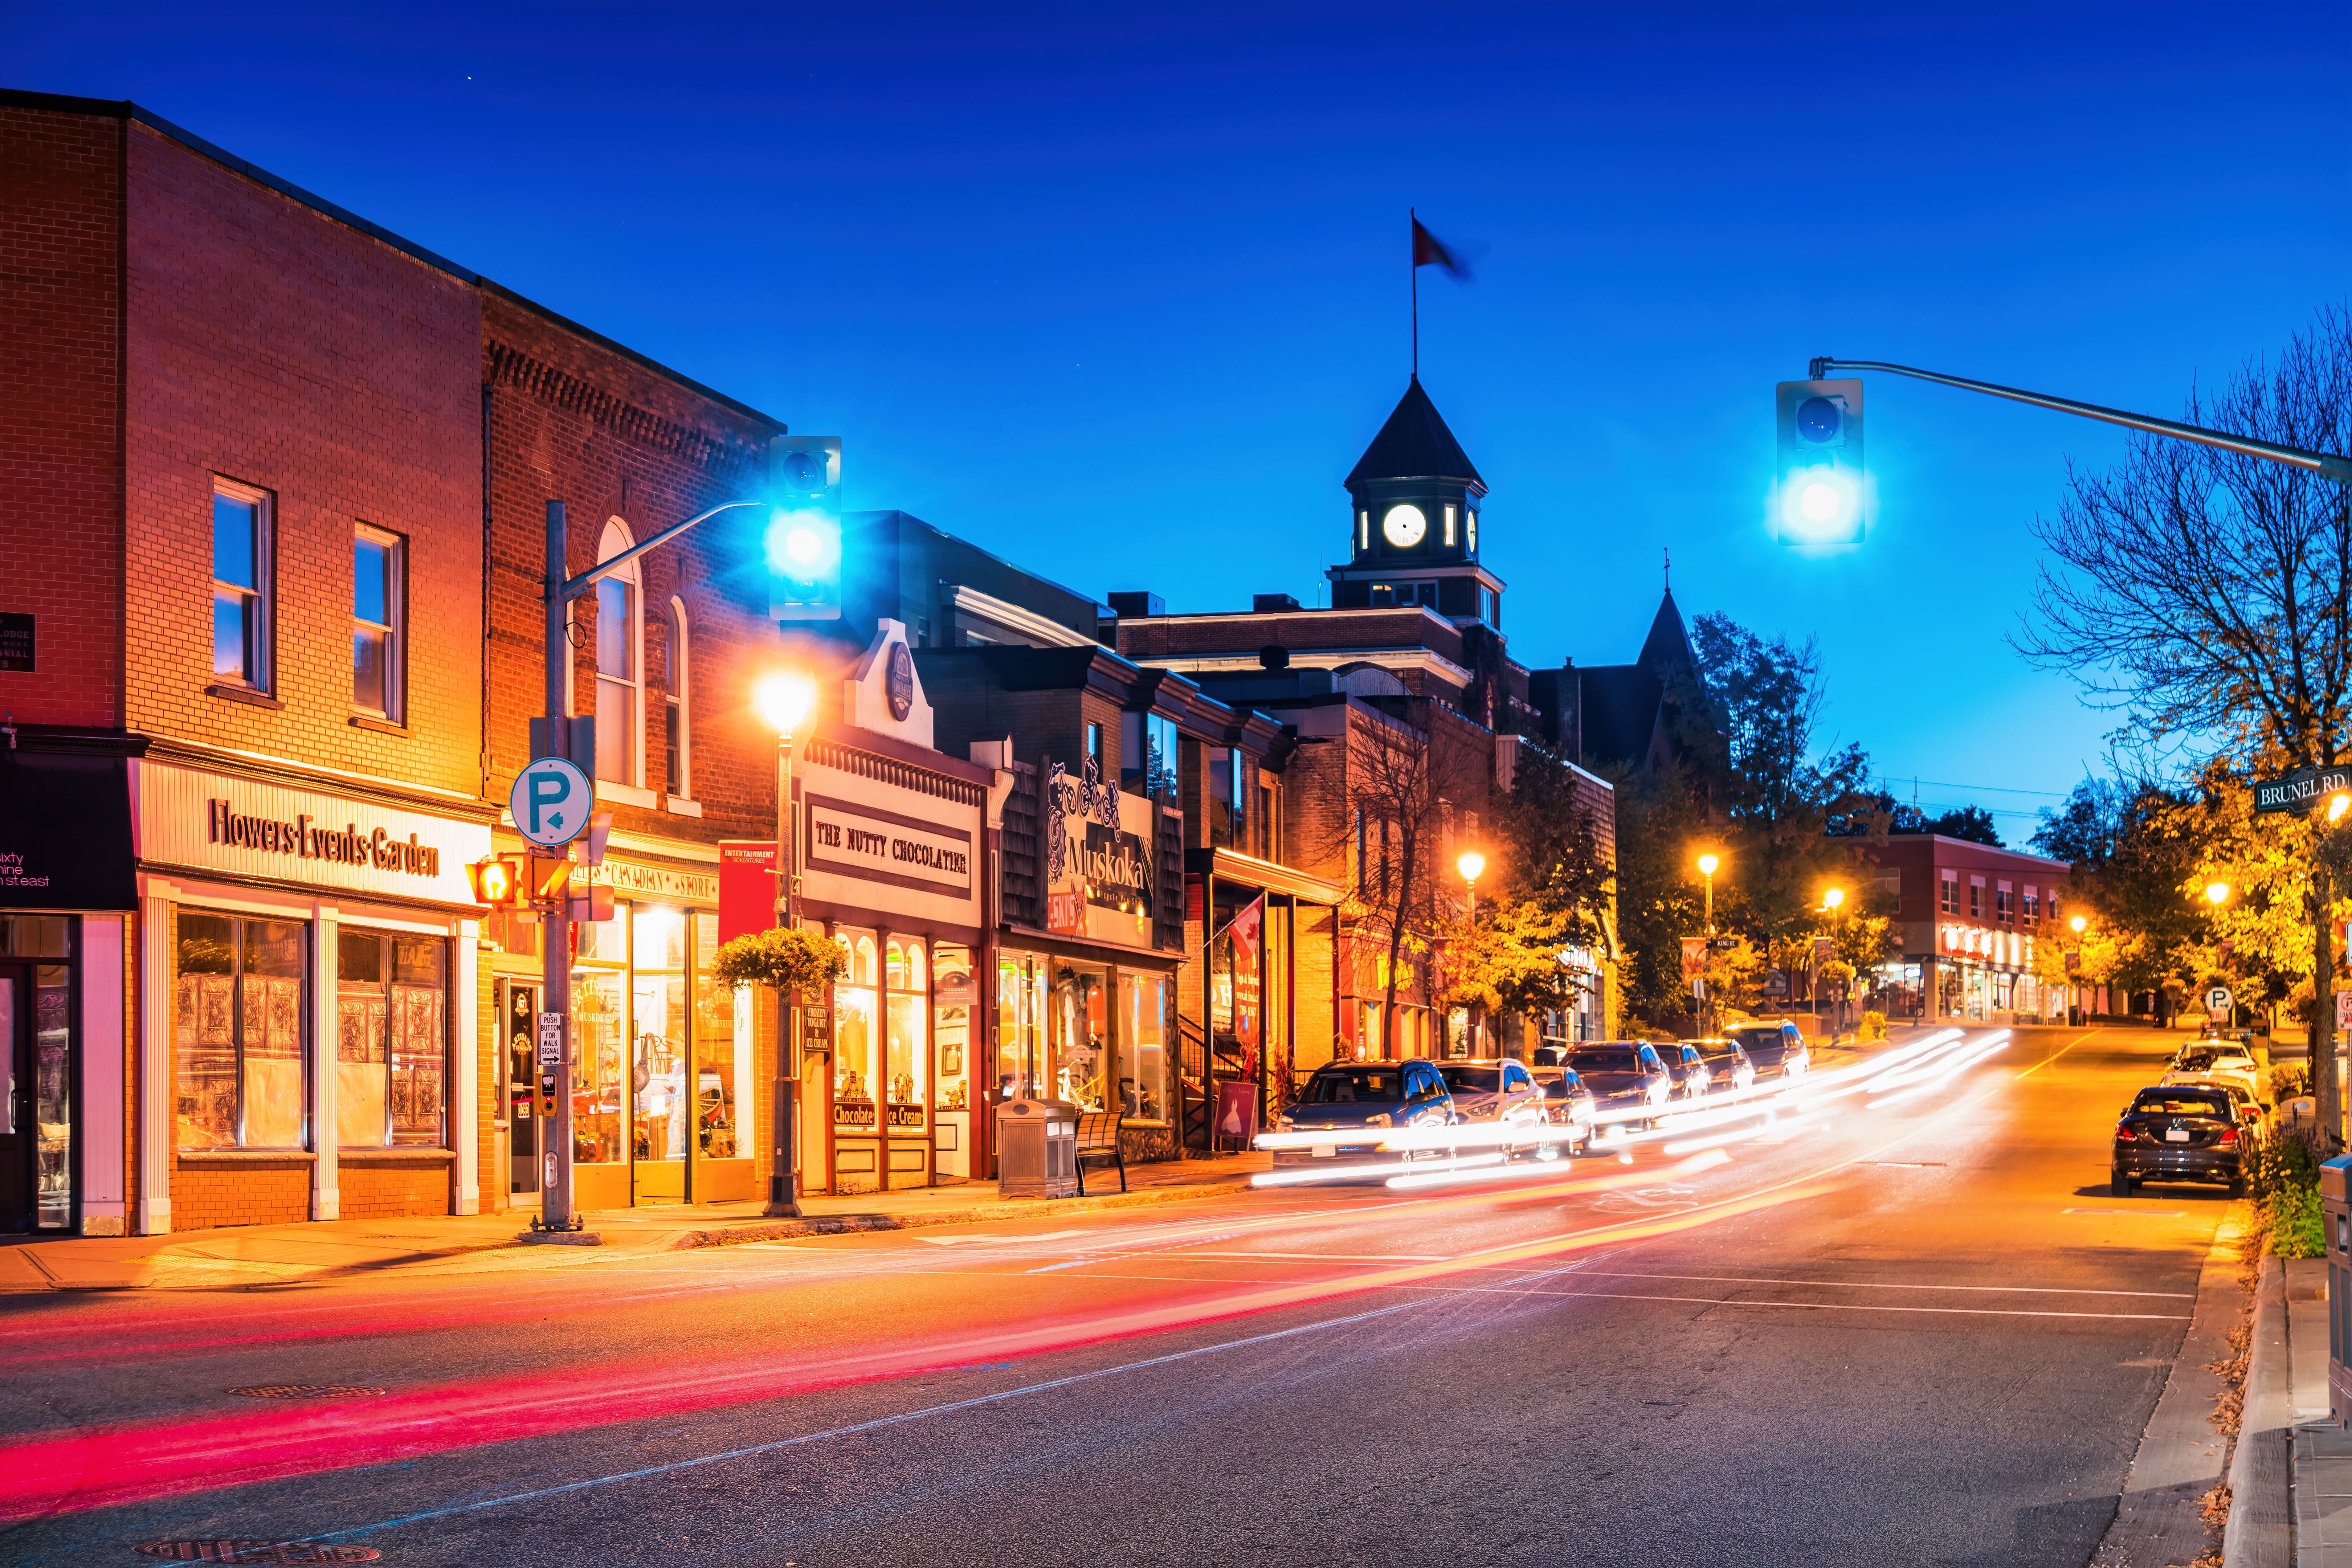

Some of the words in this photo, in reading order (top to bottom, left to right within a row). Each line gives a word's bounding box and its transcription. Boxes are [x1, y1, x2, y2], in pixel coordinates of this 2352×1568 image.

[0, 630, 29, 638] ODGE
[2260, 779, 2319, 805] BRUNEL
[2322, 774, 2348, 792] RD.
[529, 771, 571, 833] P
[208, 799, 295, 854] Flowers
[297, 814, 368, 866] Events
[371, 827, 439, 877] Garden
[816, 821, 841, 847] THE
[847, 828, 887, 857] NUTTY
[892, 838, 967, 874] CHOCOLATIER
[0, 852, 23, 865] ixty
[1069, 836, 1144, 889] Muskoka
[21, 876, 49, 886] east
[611, 864, 663, 891] CANADIAN
[680, 875, 710, 897] STORE
[571, 980, 616, 1024] ARTISANS
[2213, 991, 2226, 1008] P
[578, 1012, 609, 1023] MUSKOKA
[808, 1007, 826, 1018] FROZEN
[807, 1017, 826, 1028] YOGURT
[815, 1028, 819, 1037] &
[813, 1038, 828, 1048] CREAM
[834, 1105, 874, 1124] Chocolate
[899, 1107, 922, 1124] Cream
